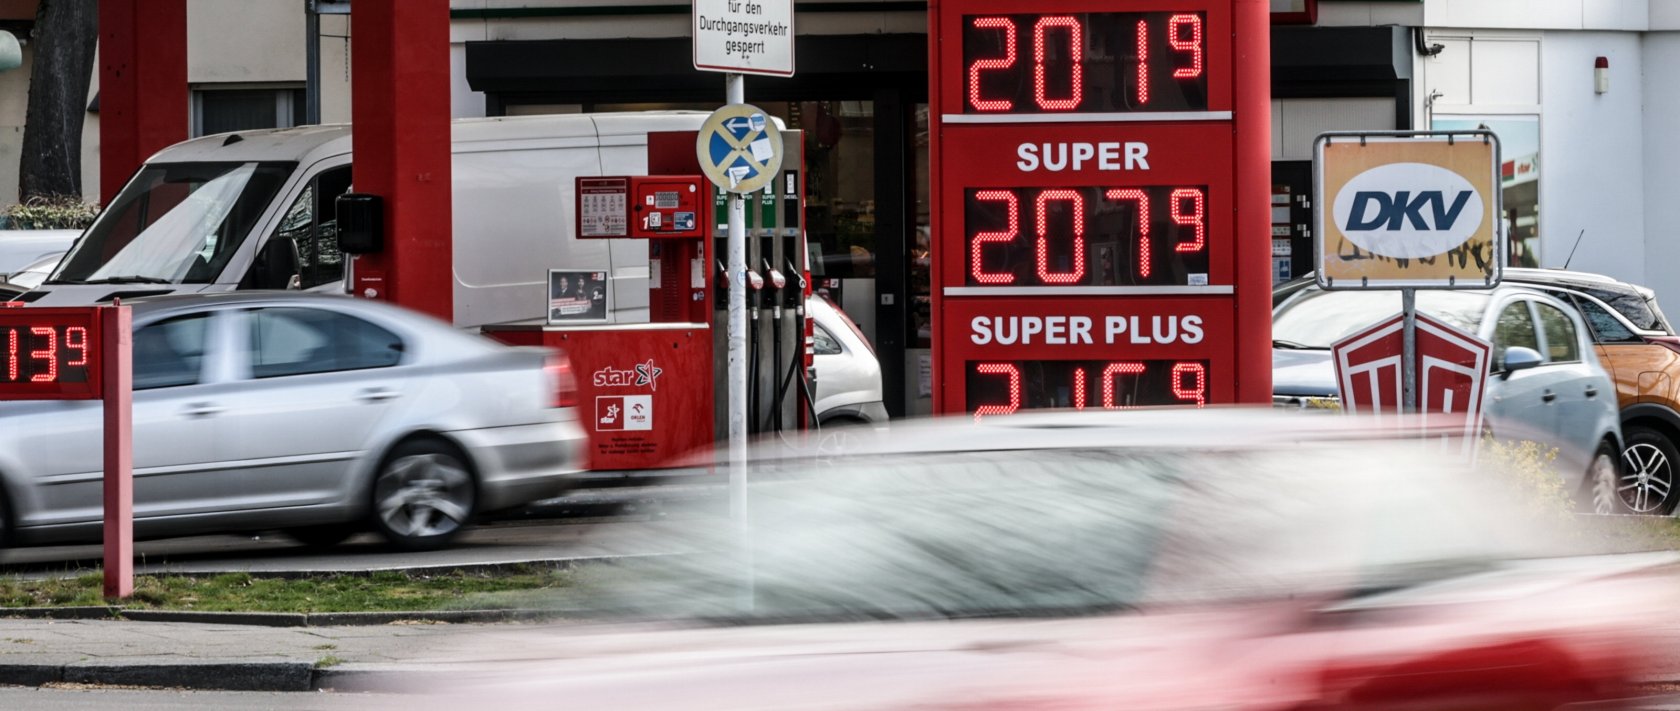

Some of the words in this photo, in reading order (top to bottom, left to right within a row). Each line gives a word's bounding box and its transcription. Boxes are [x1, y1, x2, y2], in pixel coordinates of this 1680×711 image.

[728, 0, 741, 13] für
[746, 0, 762, 15] den
[699, 16, 788, 37] Durchgangsverkehr
[725, 40, 765, 55] gesperrt
[1016, 141, 1150, 172] SUPER
[1345, 190, 1474, 231] DKV
[970, 315, 1093, 346] SUPER
[1105, 315, 1204, 345] PLUS
[593, 365, 634, 386] star
